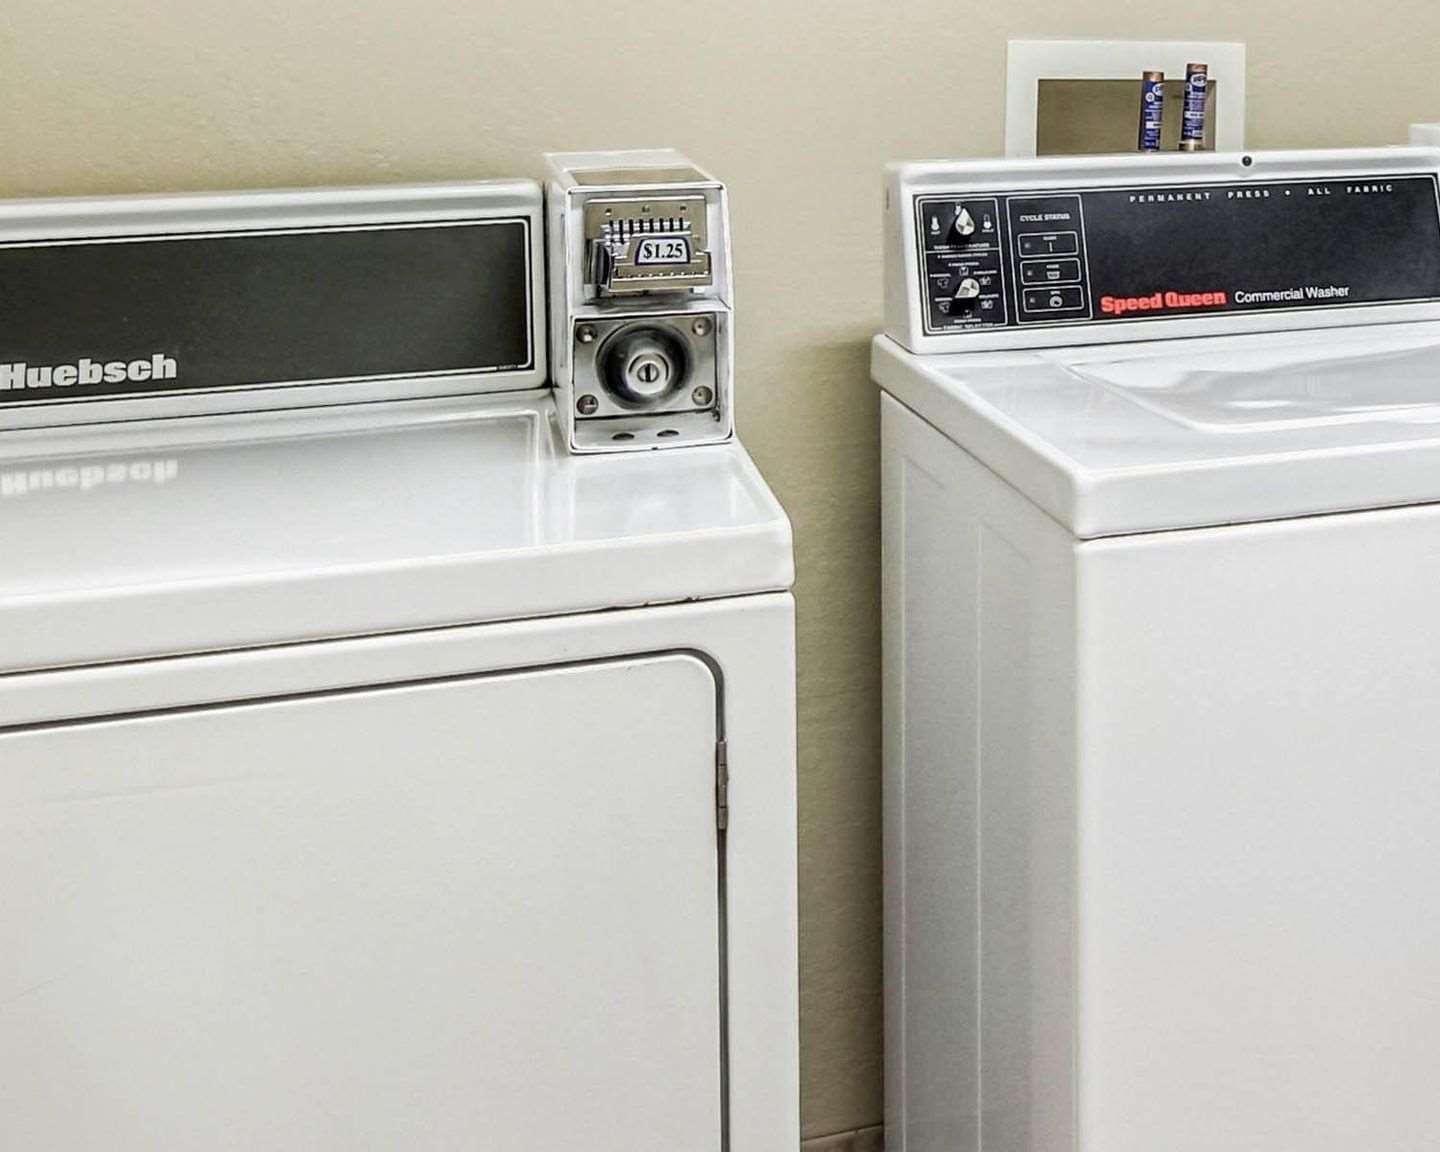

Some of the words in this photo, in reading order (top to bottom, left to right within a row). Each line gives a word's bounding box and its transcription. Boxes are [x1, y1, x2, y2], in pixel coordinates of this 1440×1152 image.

[1129, 192, 1211, 203] PERMANENT
[1227, 189, 1271, 199] PRESS
[1308, 187, 1331, 196] ALL
[1347, 184, 1393, 193] FABRIC
[1019, 214, 1043, 222] CYCLE
[643, 243, 684, 260] $1.25
[1101, 293, 1163, 315] Speed
[1165, 291, 1226, 308] Queen
[1234, 289, 1304, 304] Commercial
[1305, 286, 1350, 299] Washer
[0, 353, 177, 390] Huebsch
